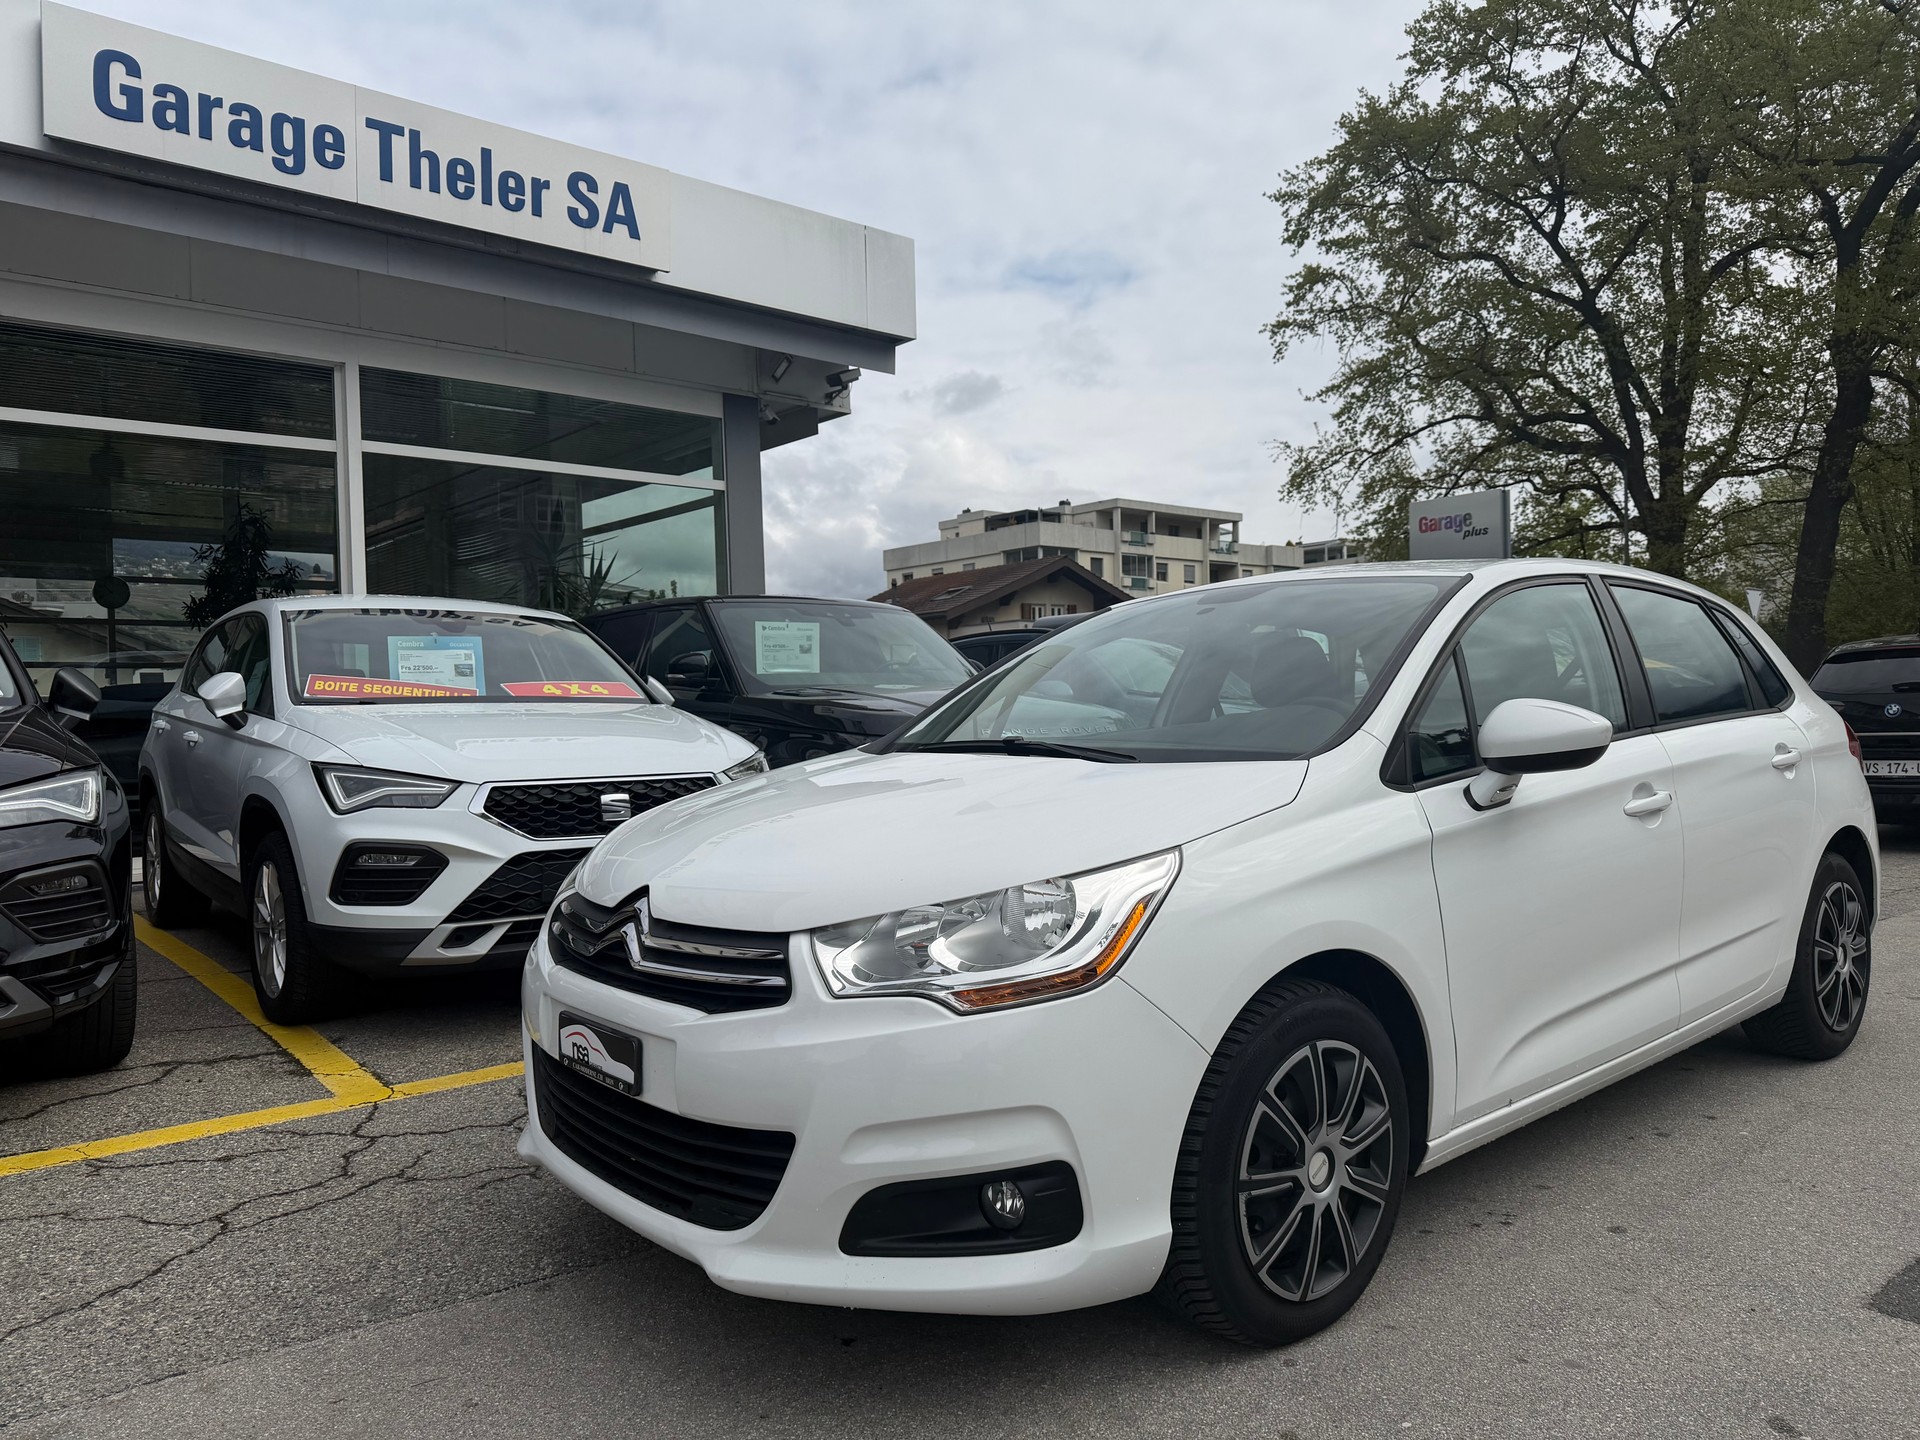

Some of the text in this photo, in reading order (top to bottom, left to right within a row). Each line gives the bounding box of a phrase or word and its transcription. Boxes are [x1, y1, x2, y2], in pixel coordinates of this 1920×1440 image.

[93, 49, 641, 240] Garage Theler SA
[1418, 512, 1473, 533] Garage
[1462, 526, 1489, 540] plus
[314, 680, 359, 693] BOITE
[1061, 726, 1113, 735] ROVER
[572, 1041, 590, 1065] nsa
